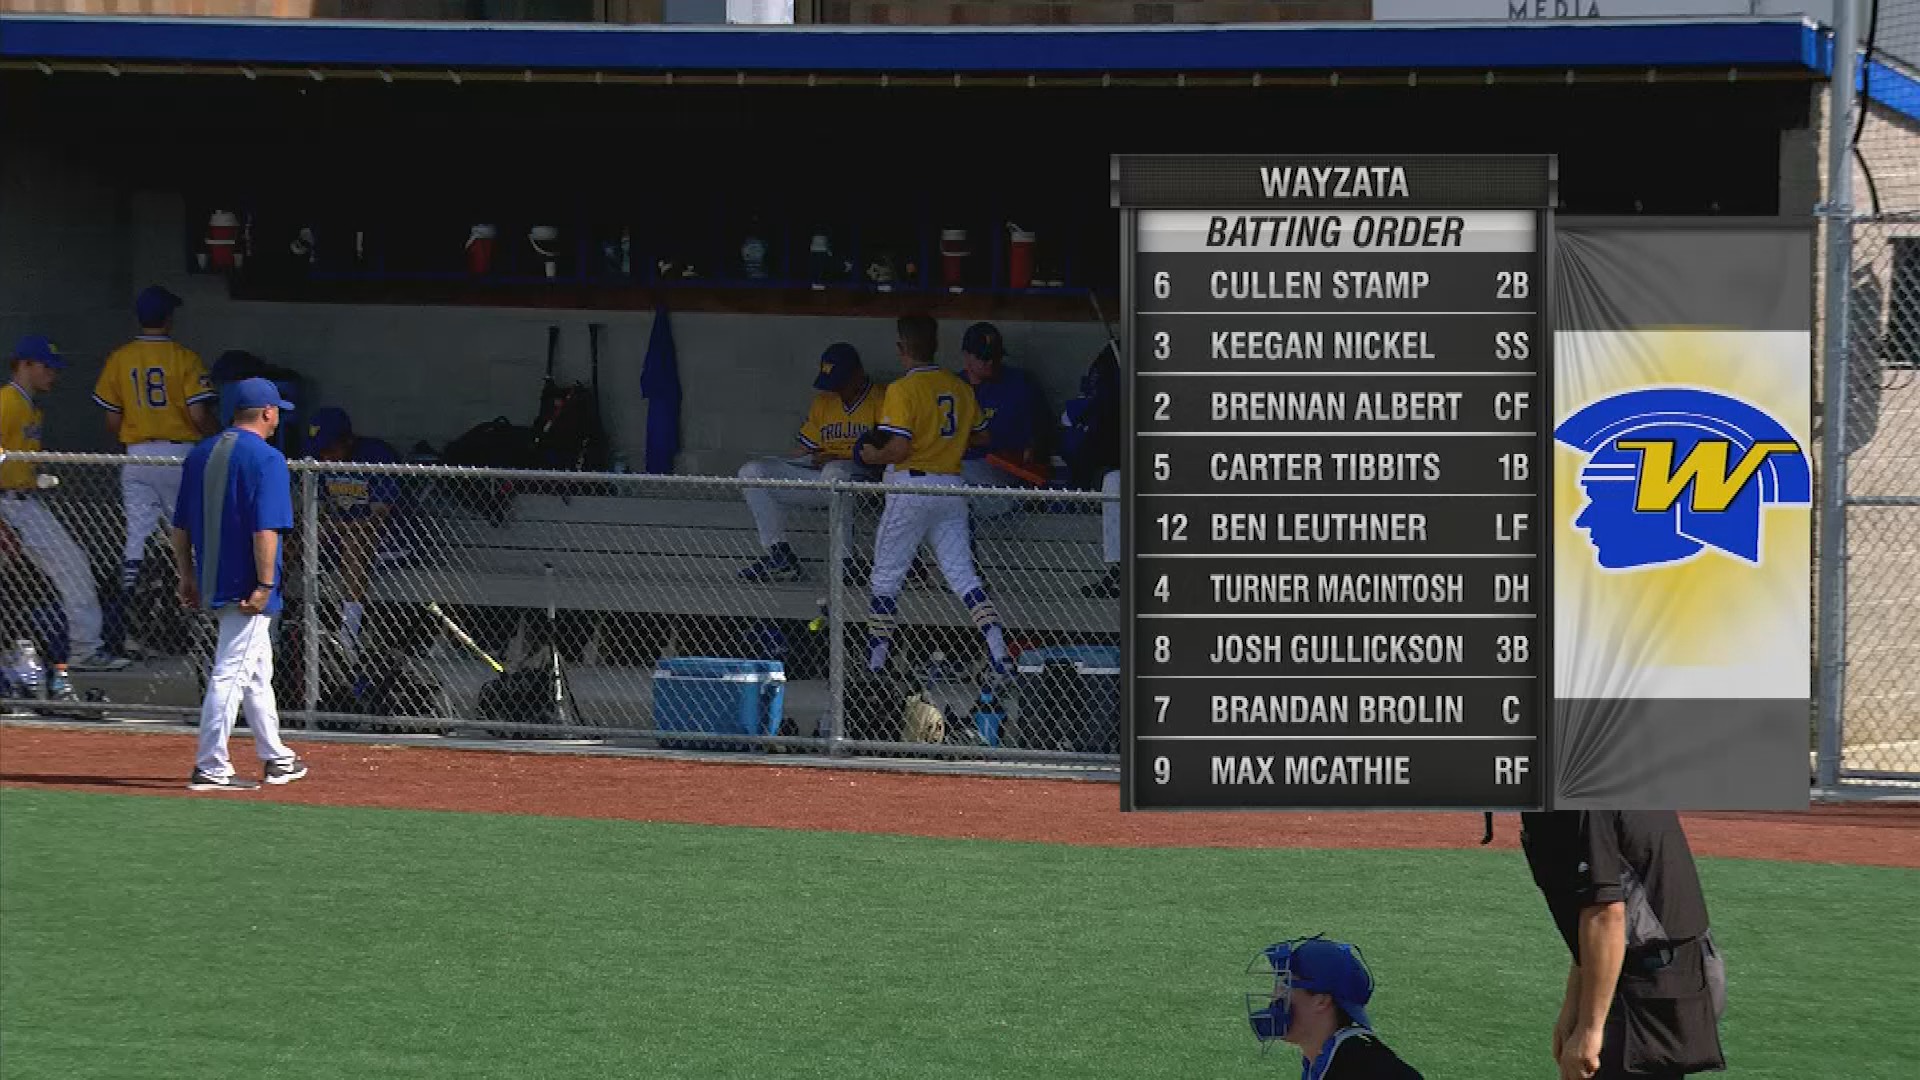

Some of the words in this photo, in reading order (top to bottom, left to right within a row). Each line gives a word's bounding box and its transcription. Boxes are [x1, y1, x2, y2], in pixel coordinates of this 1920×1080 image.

[1507, 0, 1601, 20] MEDIA
[130, 366, 167, 408] 18
[937, 392, 957, 439] 3
